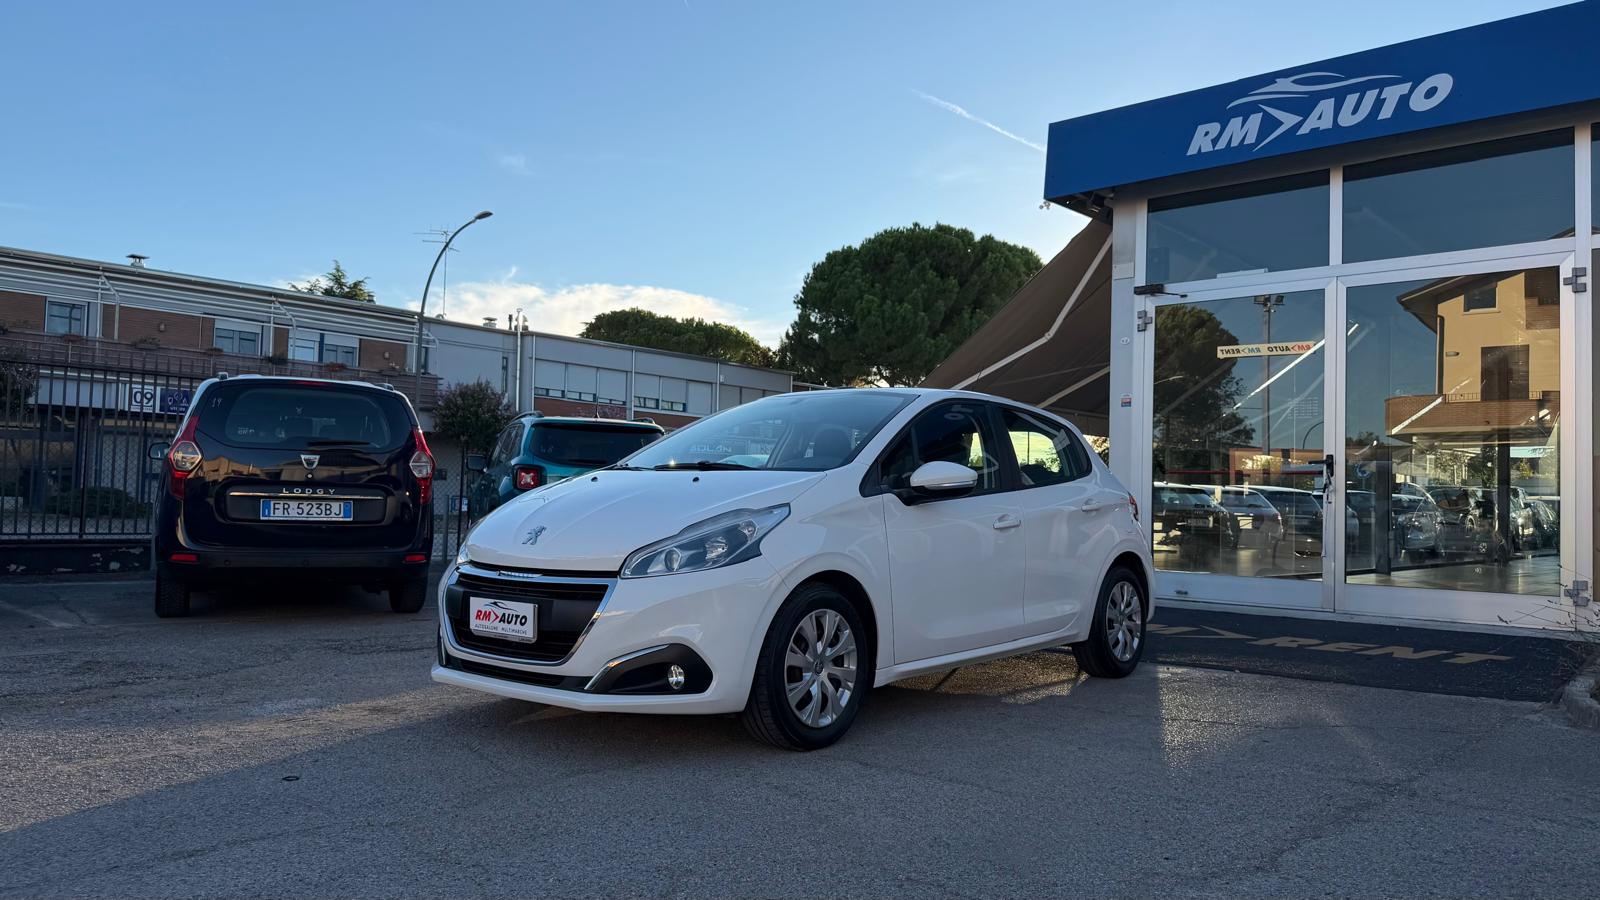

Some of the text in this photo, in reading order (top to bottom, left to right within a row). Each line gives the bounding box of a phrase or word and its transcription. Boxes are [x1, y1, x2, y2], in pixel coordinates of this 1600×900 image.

[1296, 73, 1454, 136] AUTO
[282, 487, 336, 495] LODGY
[498, 612, 528, 627] AUTO
[1246, 636, 1513, 665] RENT
